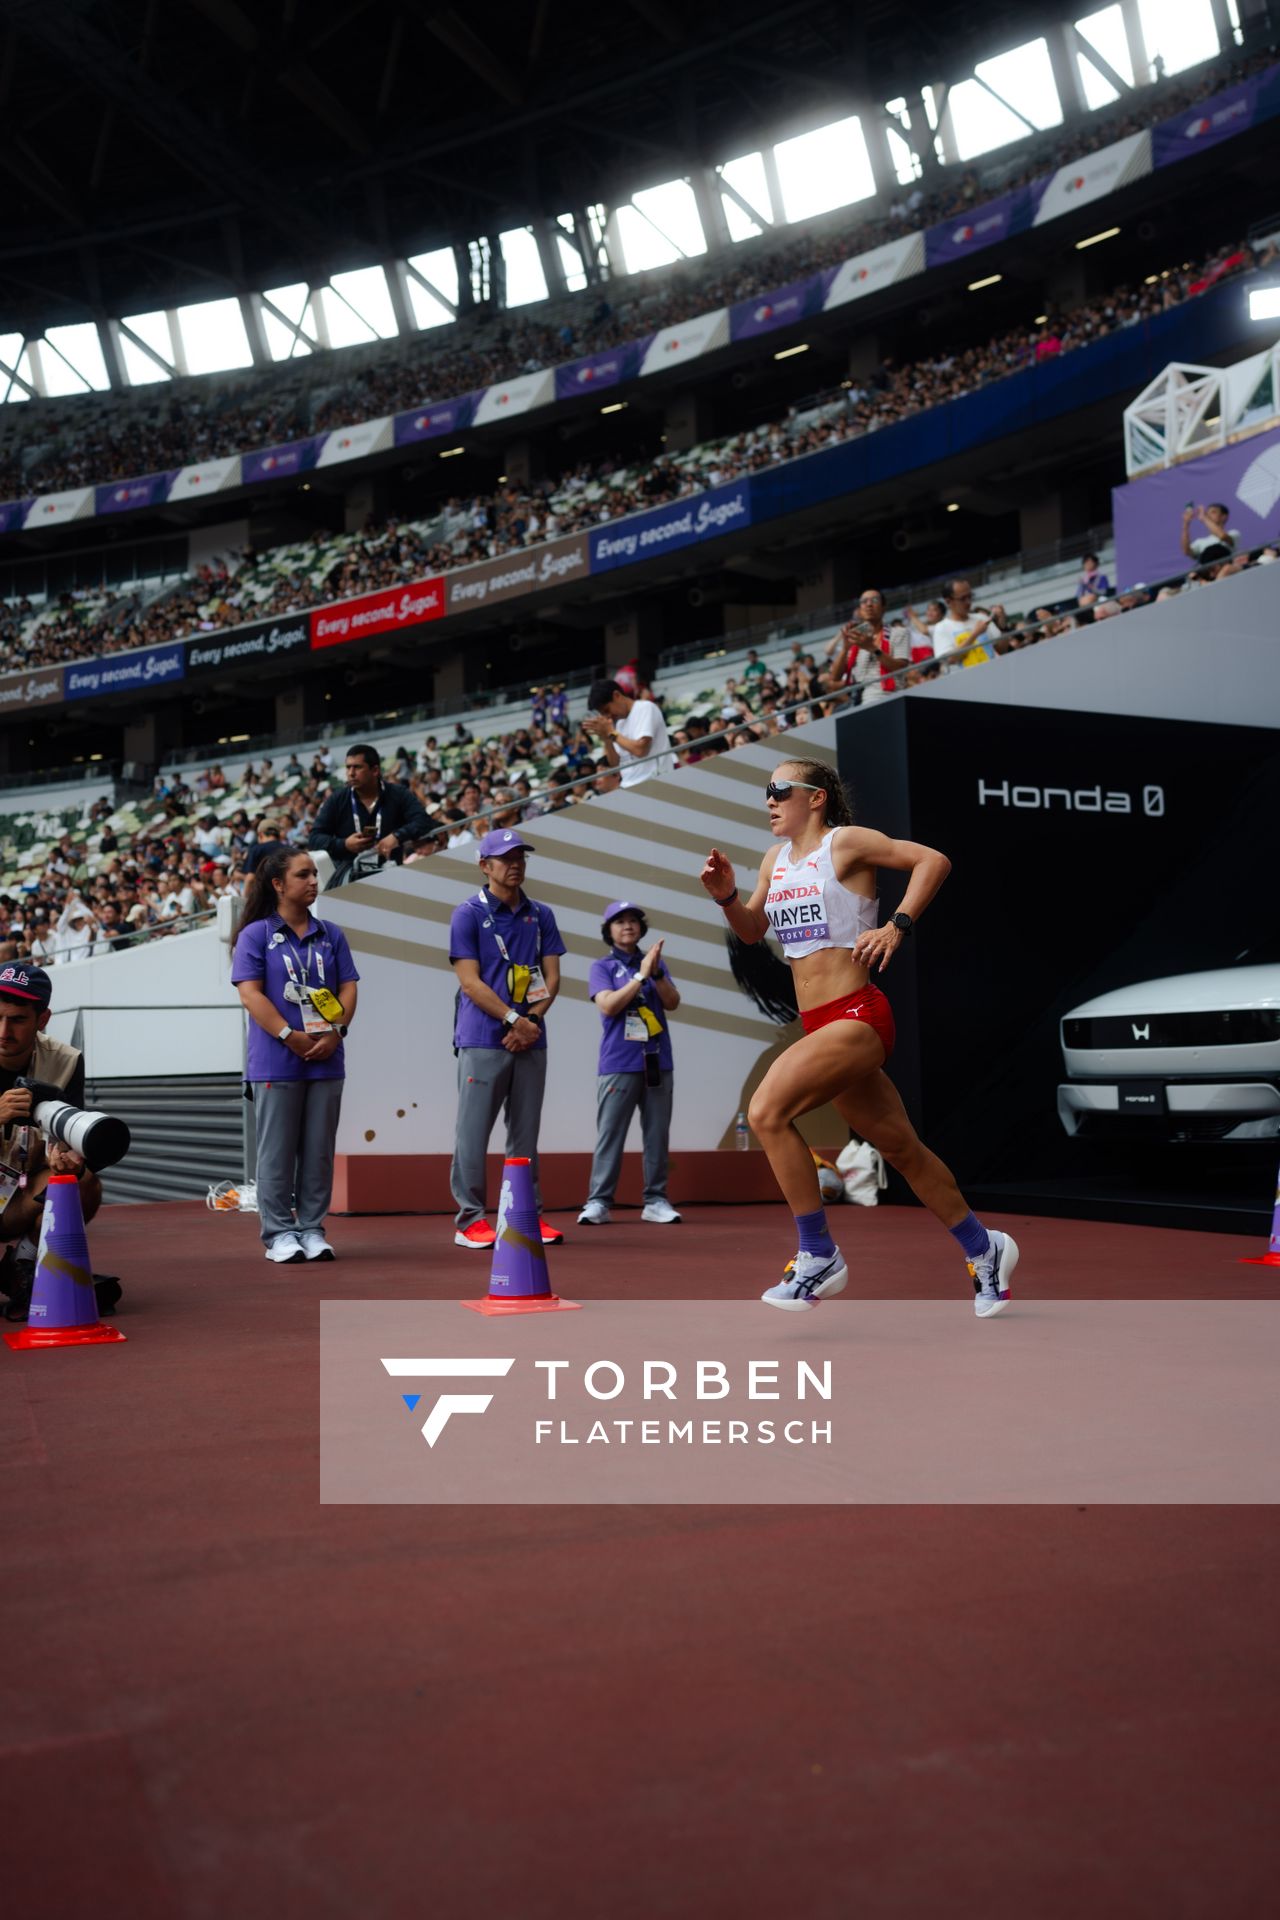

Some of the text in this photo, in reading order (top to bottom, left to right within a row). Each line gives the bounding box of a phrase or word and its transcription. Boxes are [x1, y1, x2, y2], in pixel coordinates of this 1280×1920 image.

[596, 534, 638, 560] Every
[451, 582, 487, 602] Every
[316, 618, 350, 637] Every
[189, 648, 222, 667] Every
[69, 673, 99, 690] Every
[978, 778, 1132, 814] Honda
[767, 885, 821, 904] HONDA
[767, 904, 823, 928] MAYER
